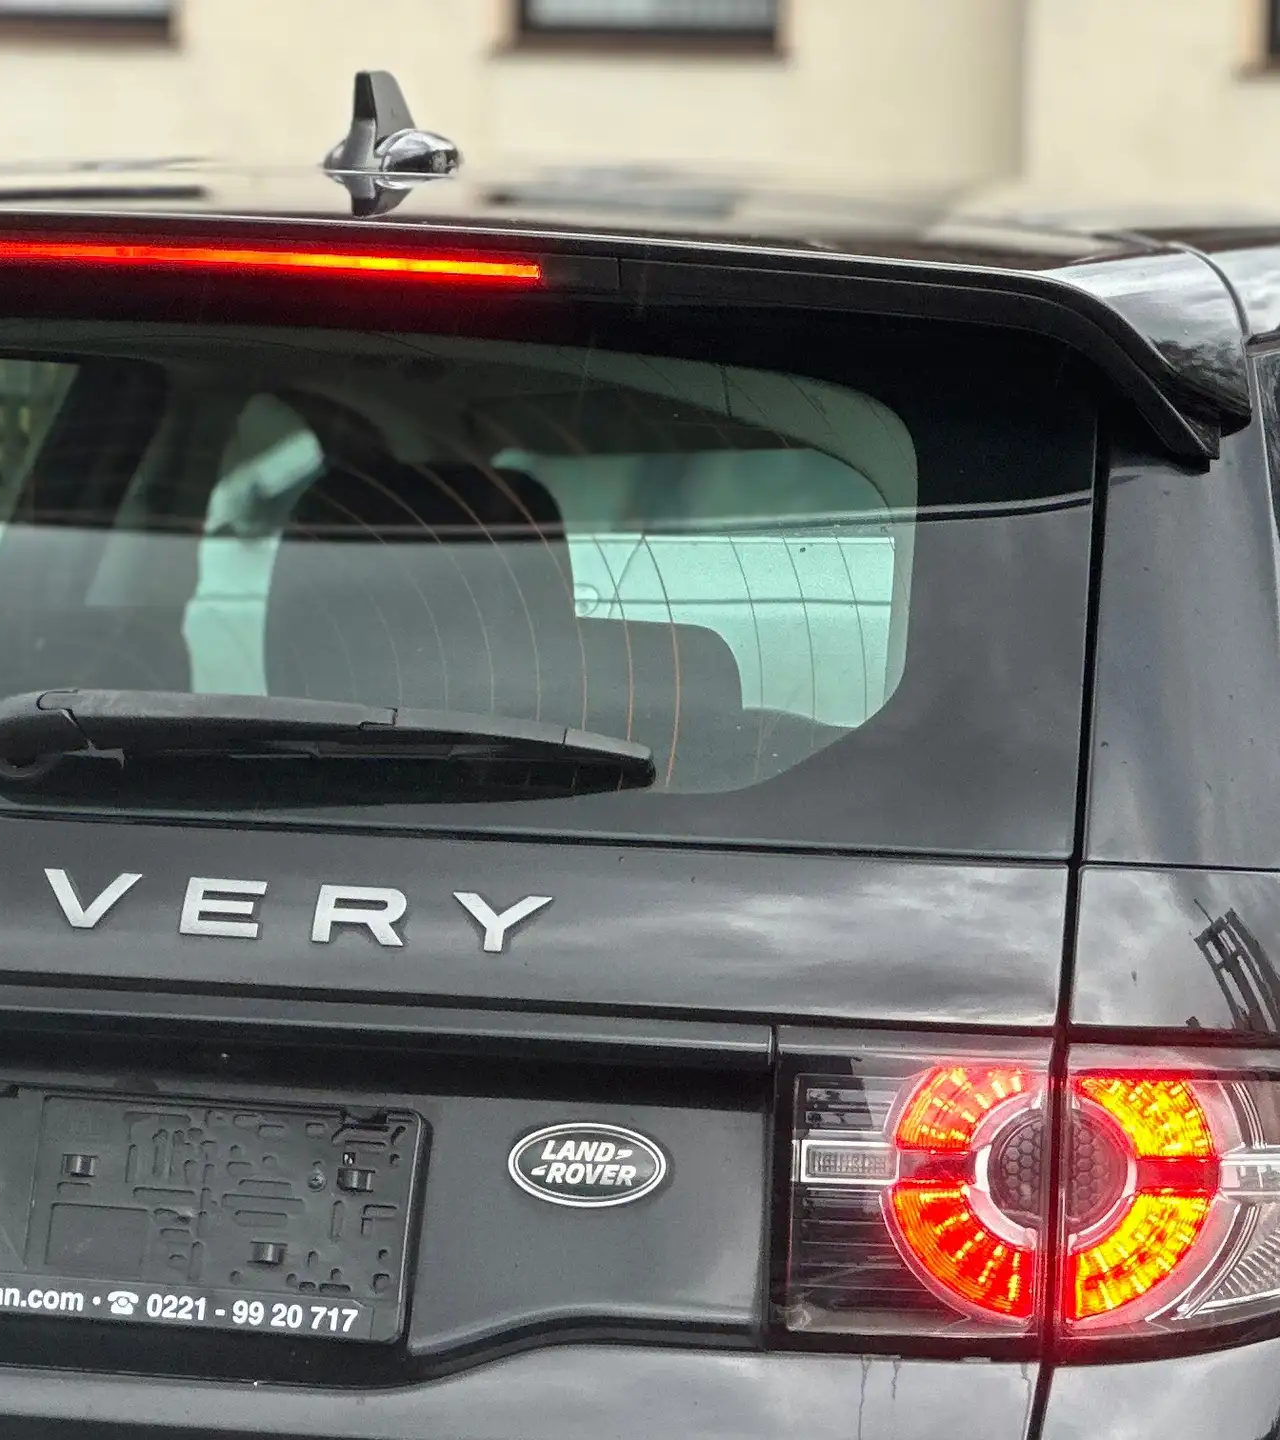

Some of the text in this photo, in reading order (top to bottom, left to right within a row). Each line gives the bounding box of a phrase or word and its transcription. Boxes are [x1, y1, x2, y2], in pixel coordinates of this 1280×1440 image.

[540, 1139, 616, 1163] LAND
[545, 1161, 638, 1187] ROVER
[146, 1293, 207, 1321] 0221
[232, 1299, 265, 1327] 99
[270, 1303, 304, 1329] 20
[310, 1305, 359, 1333] 717
